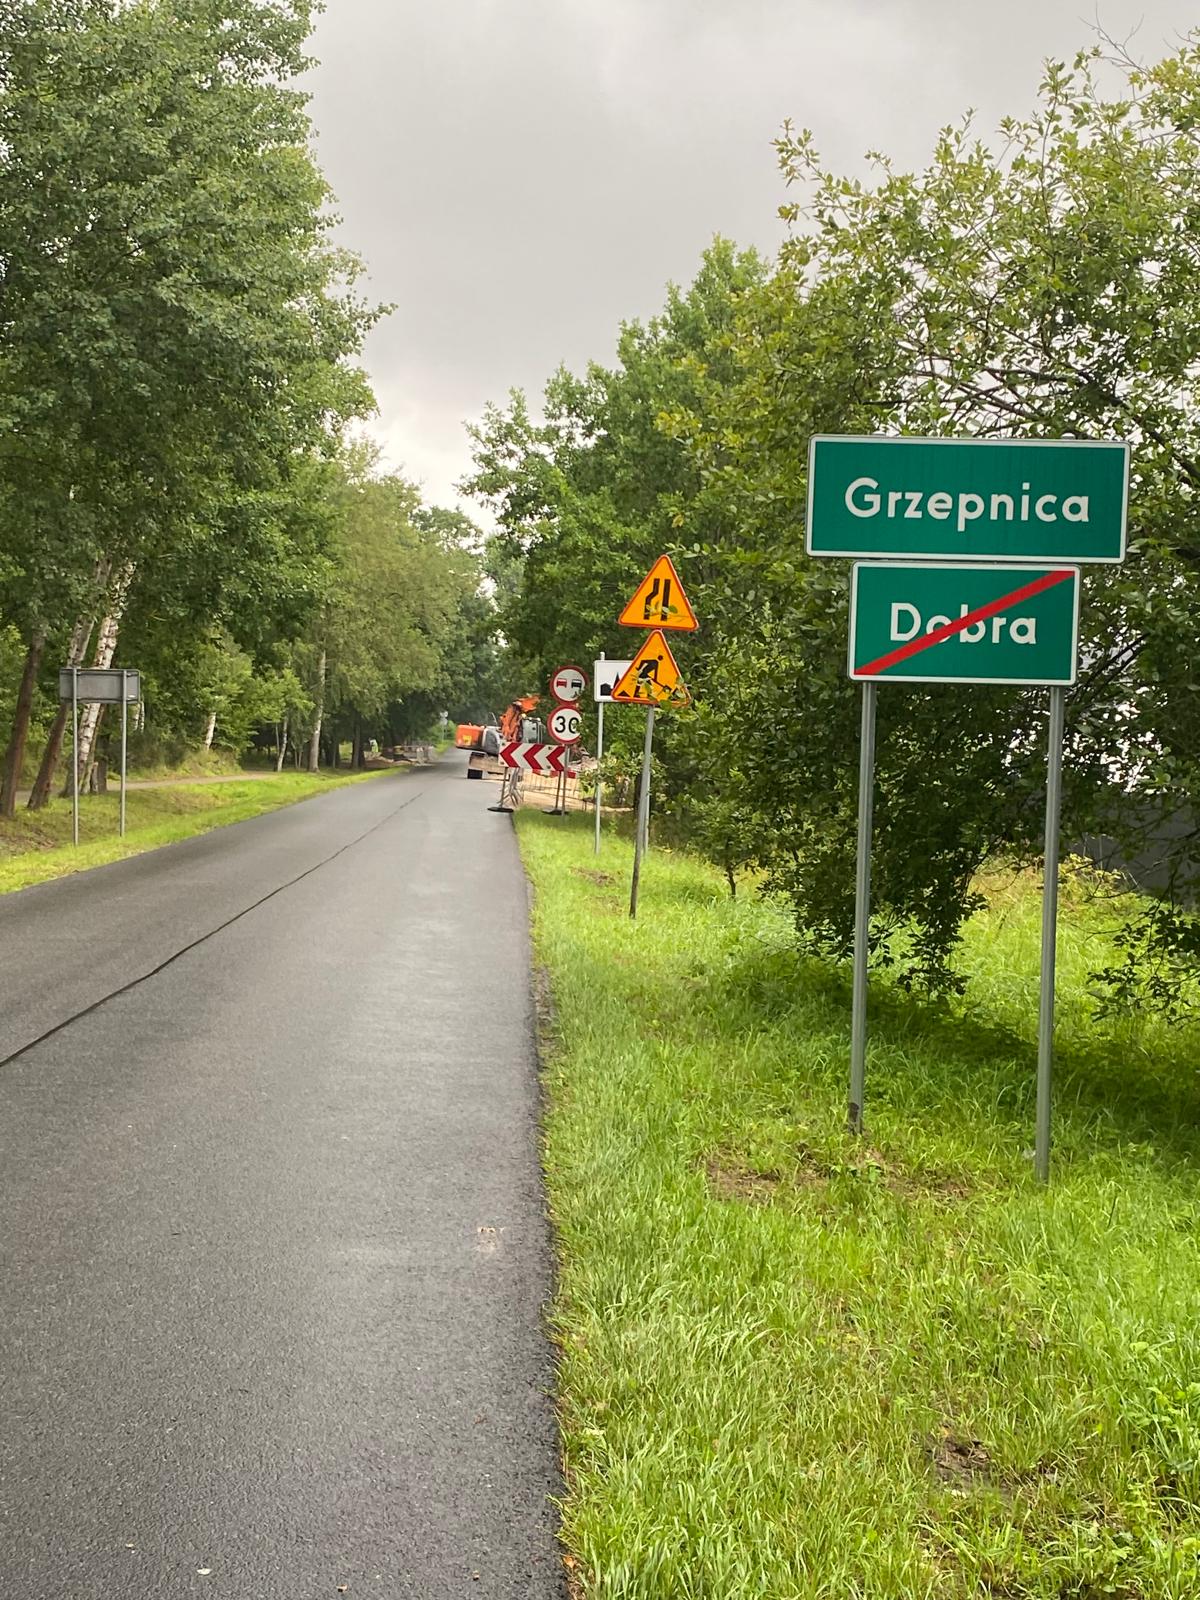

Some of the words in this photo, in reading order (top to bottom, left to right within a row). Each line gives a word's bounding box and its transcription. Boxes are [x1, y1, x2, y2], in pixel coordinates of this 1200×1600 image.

[845, 477, 1089, 532] Grzepnica
[890, 603, 1037, 644] Dobra
[555, 716, 580, 734] 30
